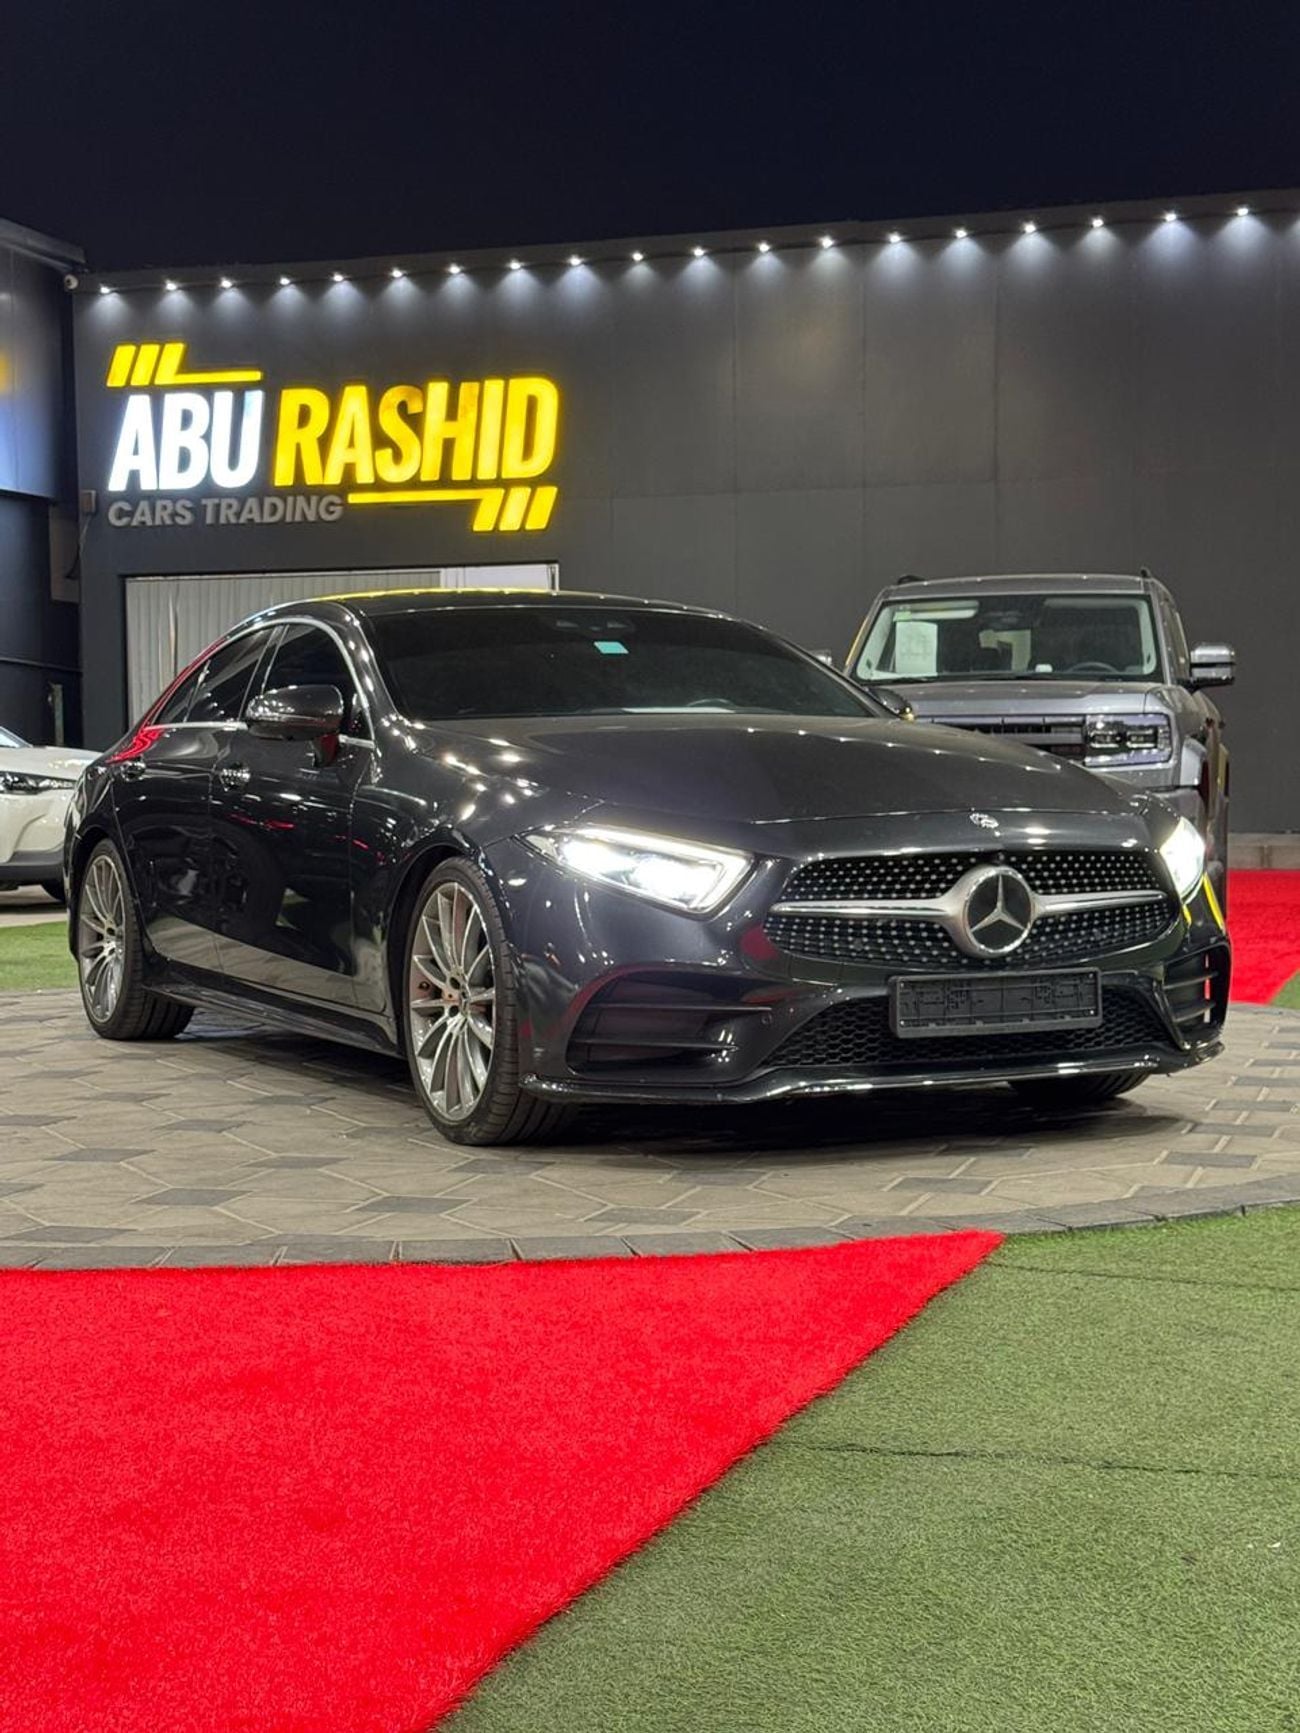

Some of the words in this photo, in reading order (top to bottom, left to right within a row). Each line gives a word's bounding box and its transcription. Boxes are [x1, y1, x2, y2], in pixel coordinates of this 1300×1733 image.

[108, 389, 264, 492] ABU
[273, 377, 558, 486] RASHID
[107, 500, 194, 527] CARS
[202, 495, 344, 524] TRADING
